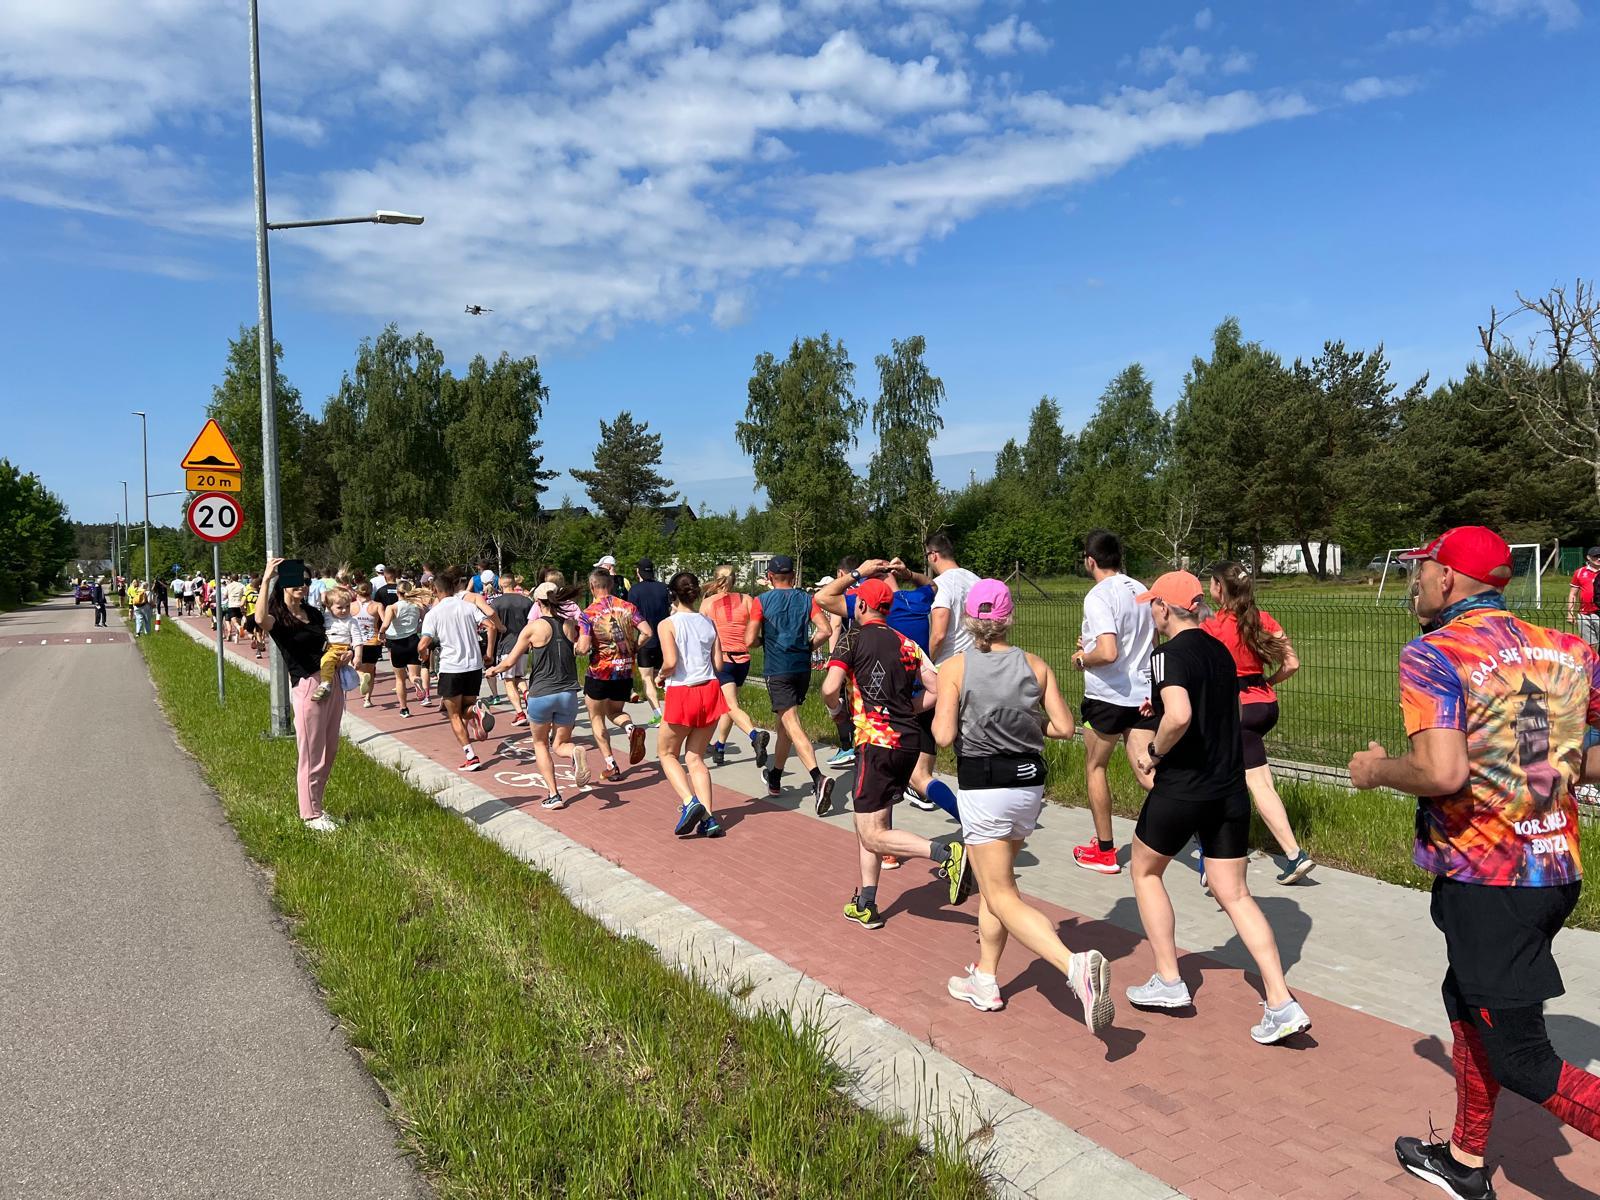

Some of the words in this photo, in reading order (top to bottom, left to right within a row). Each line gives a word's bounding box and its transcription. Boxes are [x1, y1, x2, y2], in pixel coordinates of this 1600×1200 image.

[197, 475, 215, 487] 20
[219, 479, 231, 487] m
[198, 505, 236, 529] 20
[1470, 654, 1498, 687] DAJ
